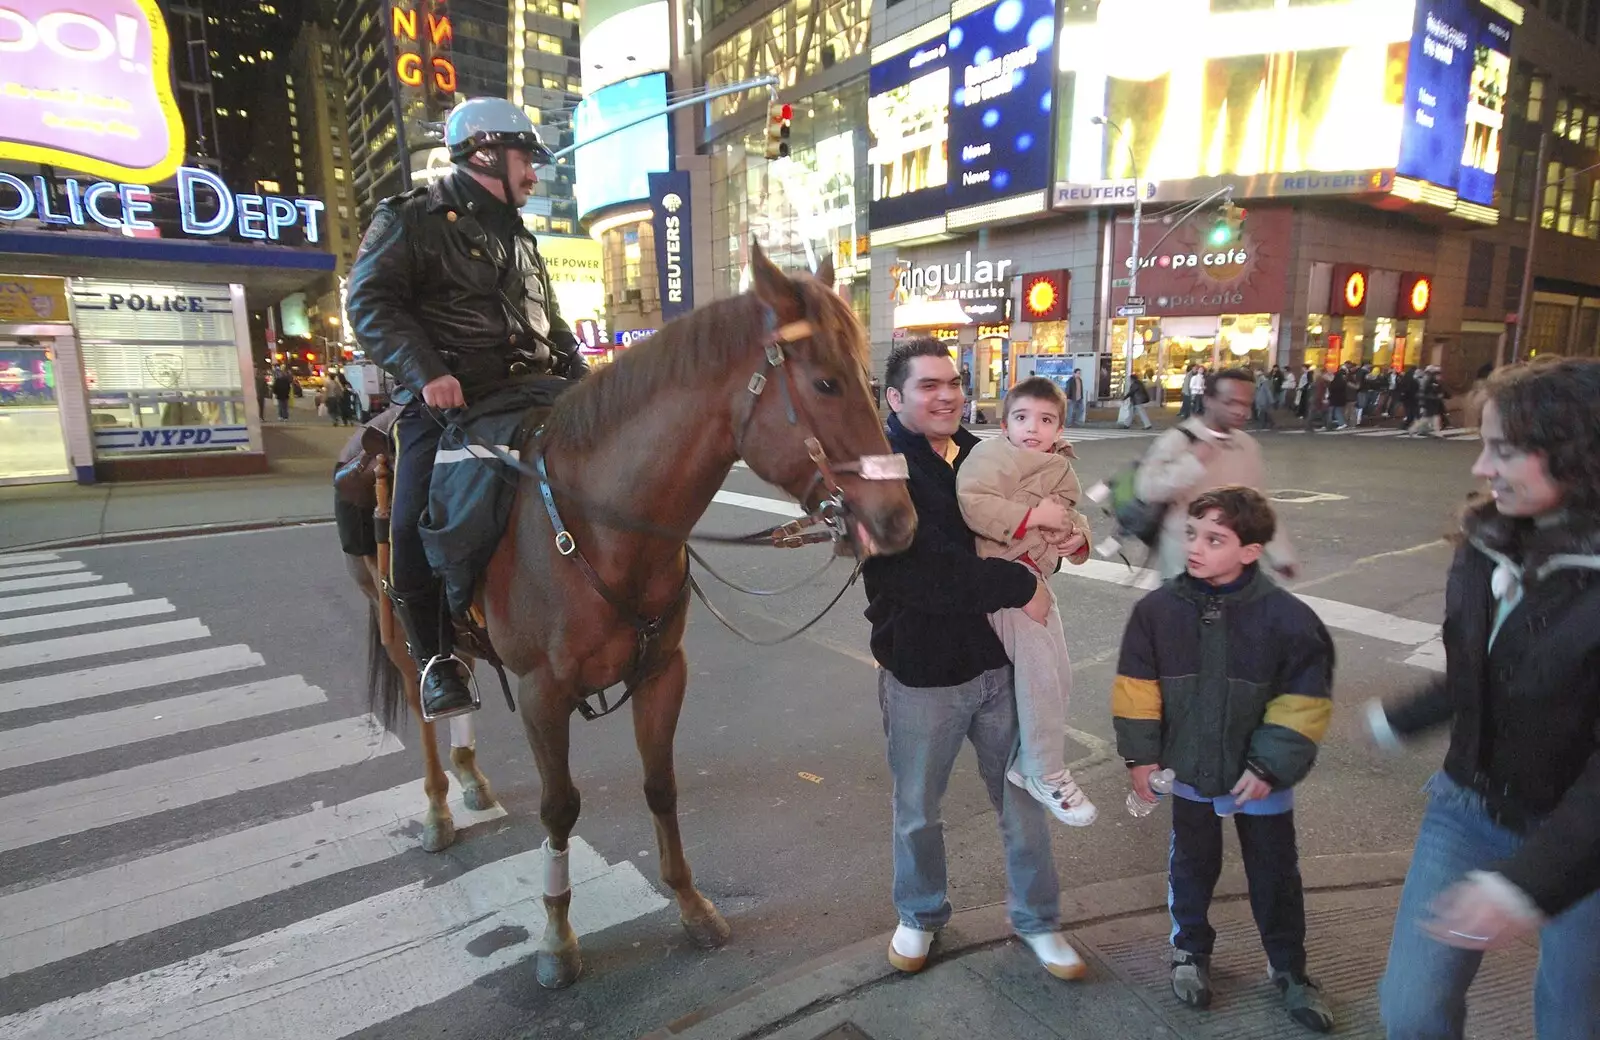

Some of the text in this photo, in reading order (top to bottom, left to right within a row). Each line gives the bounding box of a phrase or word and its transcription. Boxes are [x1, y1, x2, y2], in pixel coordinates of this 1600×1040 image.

[962, 169, 990, 186] News
[1284, 174, 1369, 190] REUTERS
[1059, 185, 1137, 200] REUTERS
[544, 257, 599, 269] HE POWER
[665, 215, 683, 303] REUTERS
[1203, 248, 1247, 266] café
[899, 250, 1012, 297] cingular
[945, 288, 1005, 299] WIRELESS
[108, 293, 204, 312] POLICE
[138, 428, 213, 447] NYPD
